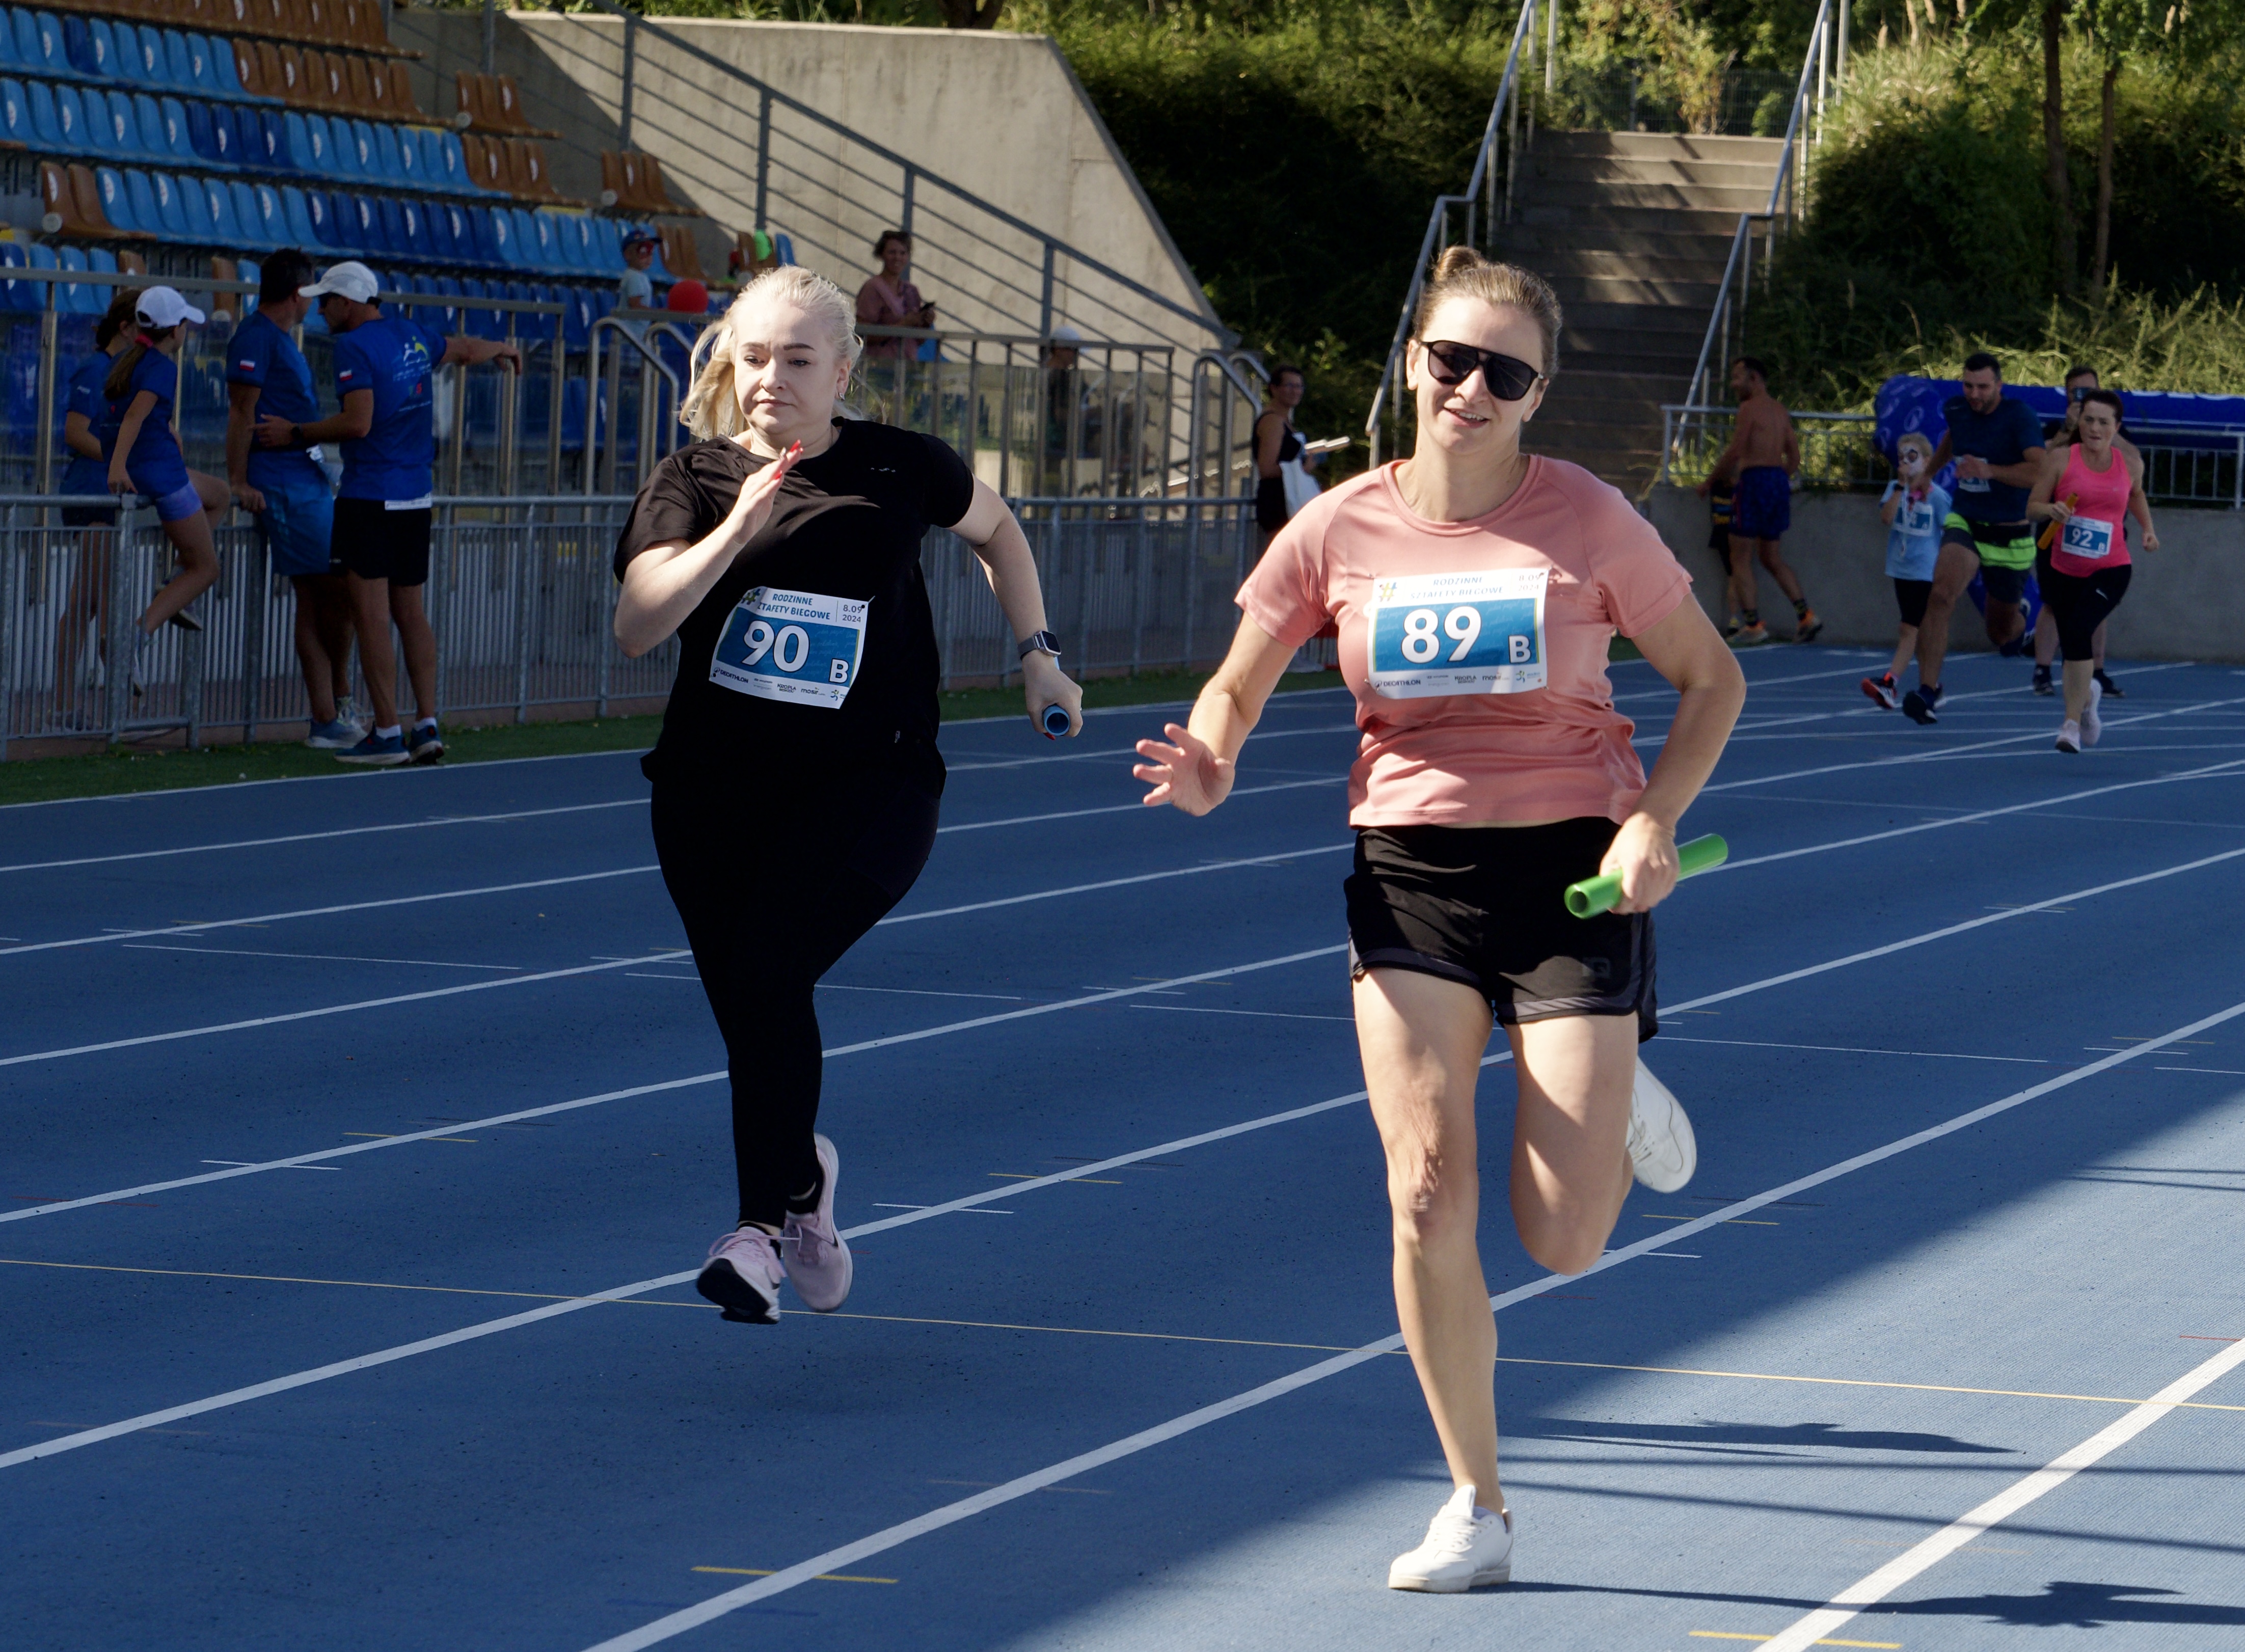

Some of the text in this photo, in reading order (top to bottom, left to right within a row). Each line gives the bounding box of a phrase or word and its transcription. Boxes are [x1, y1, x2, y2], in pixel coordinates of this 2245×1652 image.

[2070, 527, 2093, 548] 92
[1433, 577, 1484, 586] RODZINNE
[772, 593, 813, 606] RODZINNE
[1411, 586, 1504, 600] SZTAFETY BIEGOWE
[758, 603, 831, 620] ZTAFETY BIEGOWE
[843, 605, 862, 613] 8.09
[842, 614, 861, 623] 2024
[1401, 606, 1481, 664] 89
[742, 620, 810, 672] 90
[1508, 635, 1531, 663] B
[720, 669, 748, 683] DECATHLON
[829, 658, 849, 684] B
